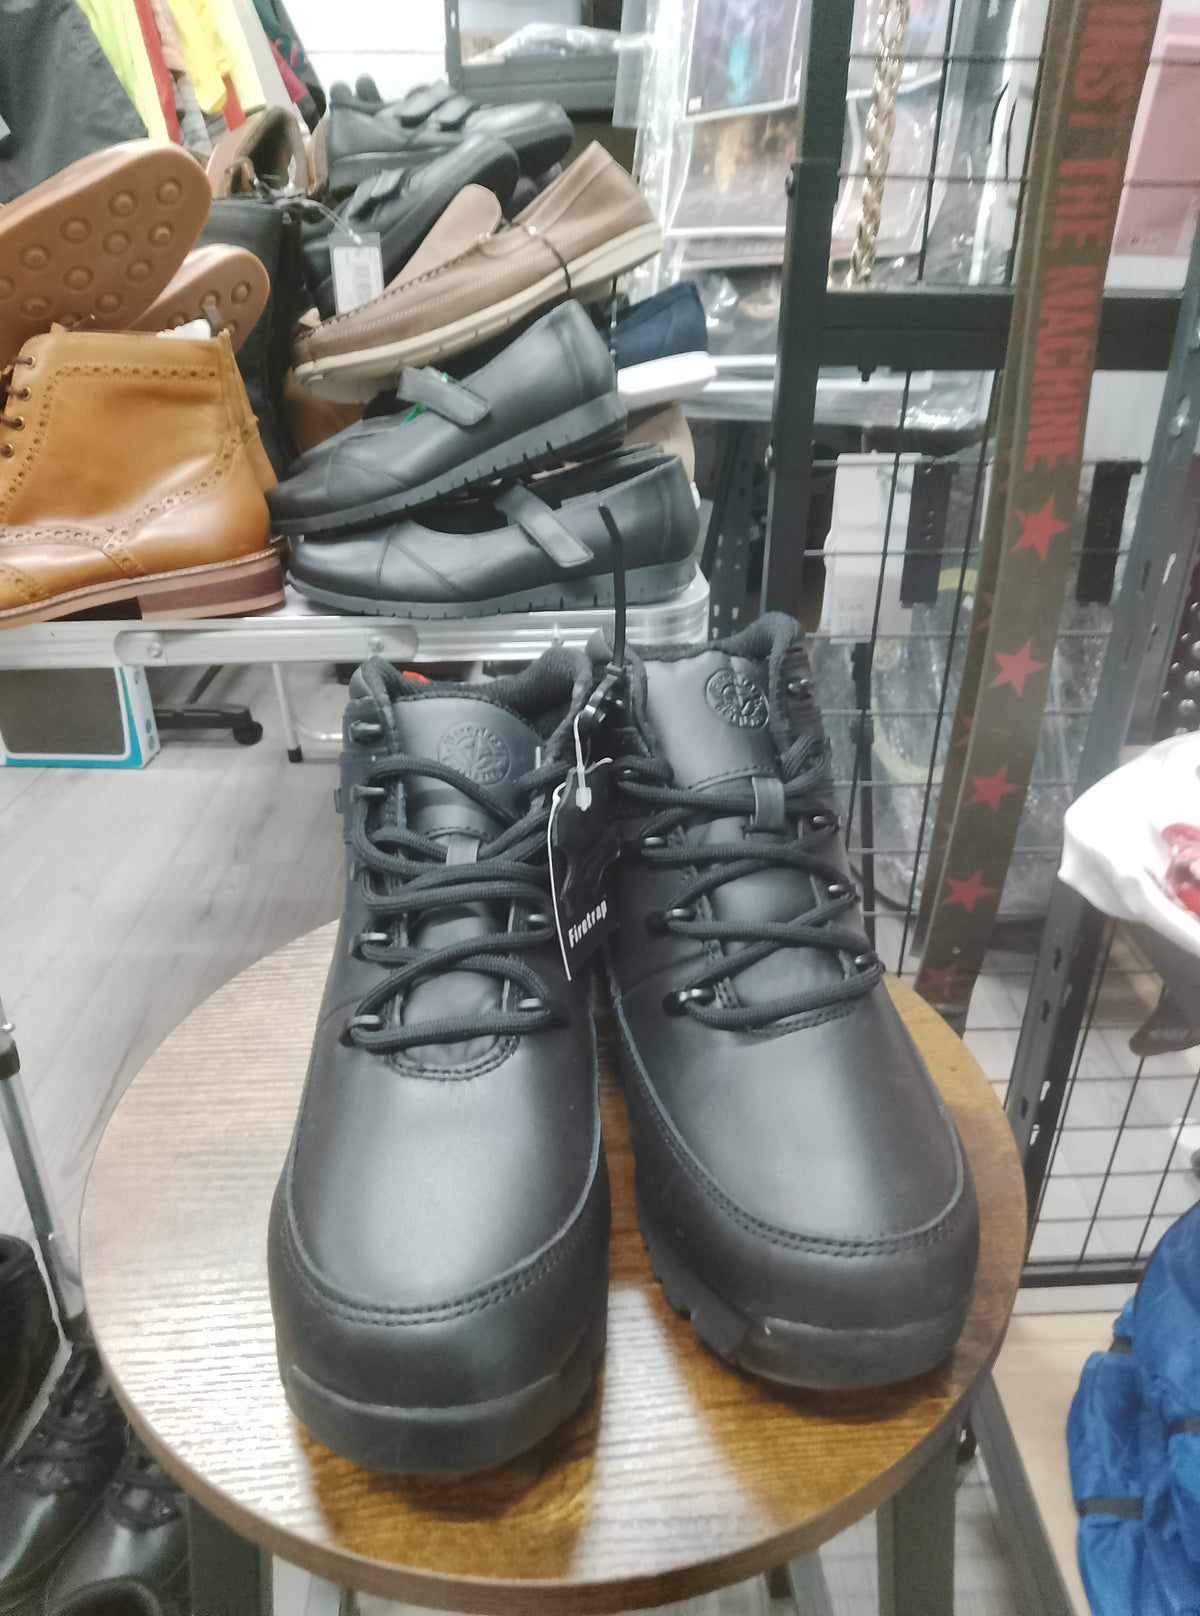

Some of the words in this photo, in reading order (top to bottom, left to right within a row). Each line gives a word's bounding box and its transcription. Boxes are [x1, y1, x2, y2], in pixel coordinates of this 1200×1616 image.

[1050, 158, 1121, 250] THE
[1023, 265, 1099, 472] MACHINE
[568, 899, 607, 949] Firetrap
